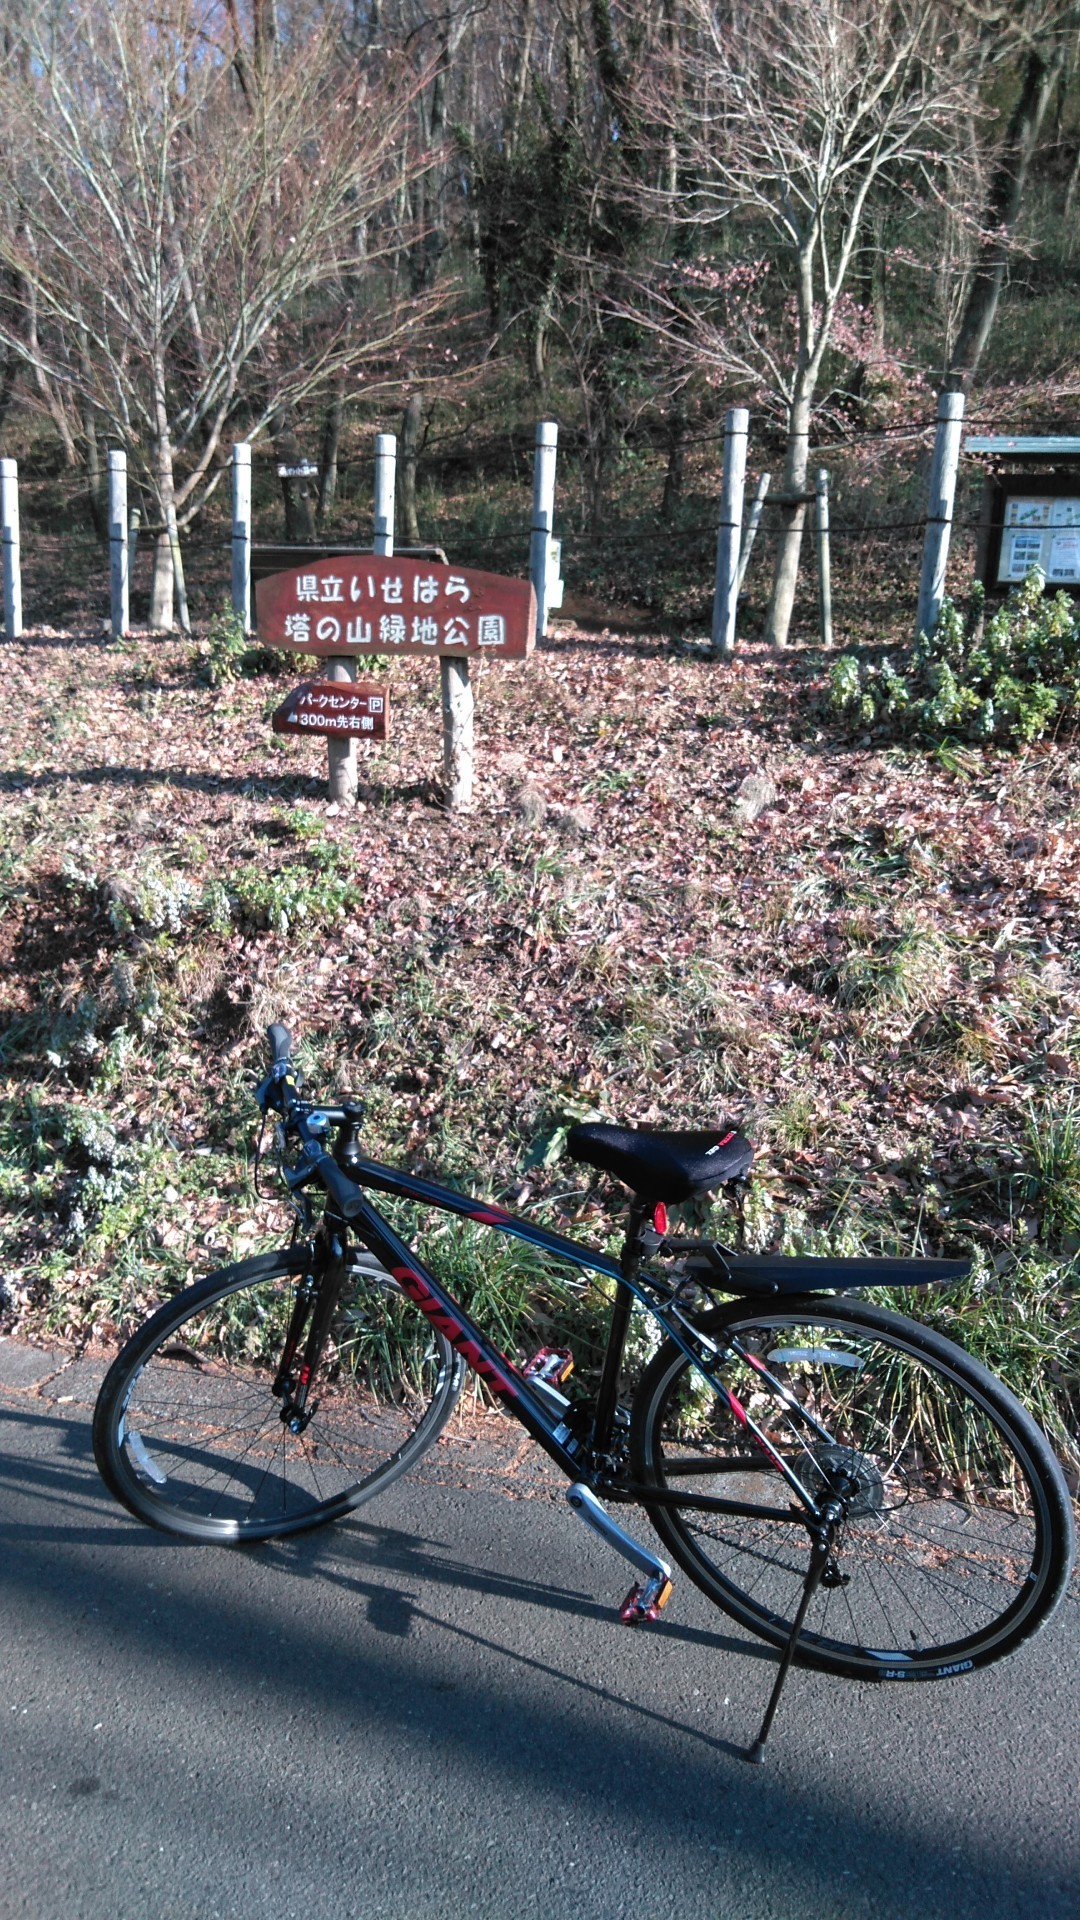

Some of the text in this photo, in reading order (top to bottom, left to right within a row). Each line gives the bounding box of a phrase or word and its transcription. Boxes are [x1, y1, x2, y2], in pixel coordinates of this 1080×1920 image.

[296, 575, 471, 603] 県立いせはら
[285, 614, 504, 645] 塔の山緑地公園
[300, 713, 374, 730] 300m先右側
[391, 1267, 518, 1397] GIANT
[936, 1660, 973, 1676] GIANT
